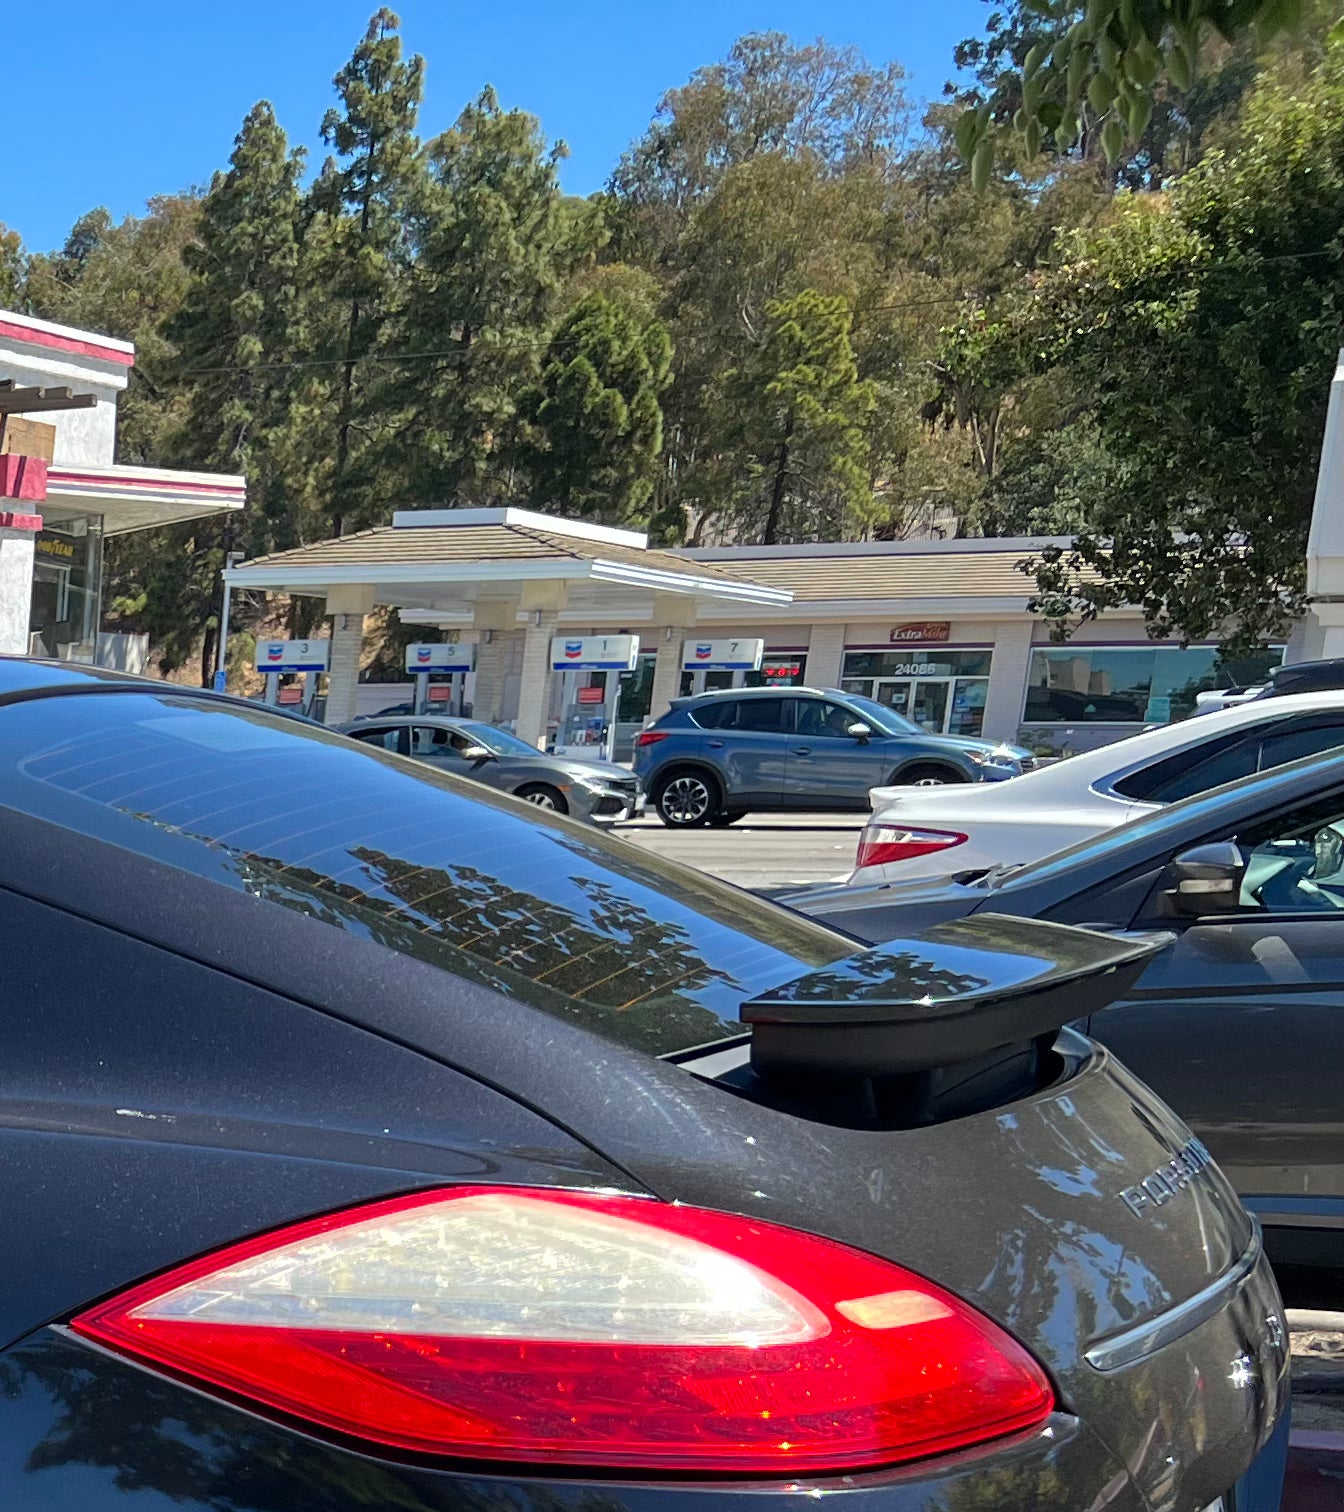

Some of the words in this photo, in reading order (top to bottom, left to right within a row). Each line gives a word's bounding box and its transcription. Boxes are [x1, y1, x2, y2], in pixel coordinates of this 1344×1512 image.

[300, 643, 309, 654] 3
[602, 640, 608, 651] 1
[731, 643, 739, 653] 7
